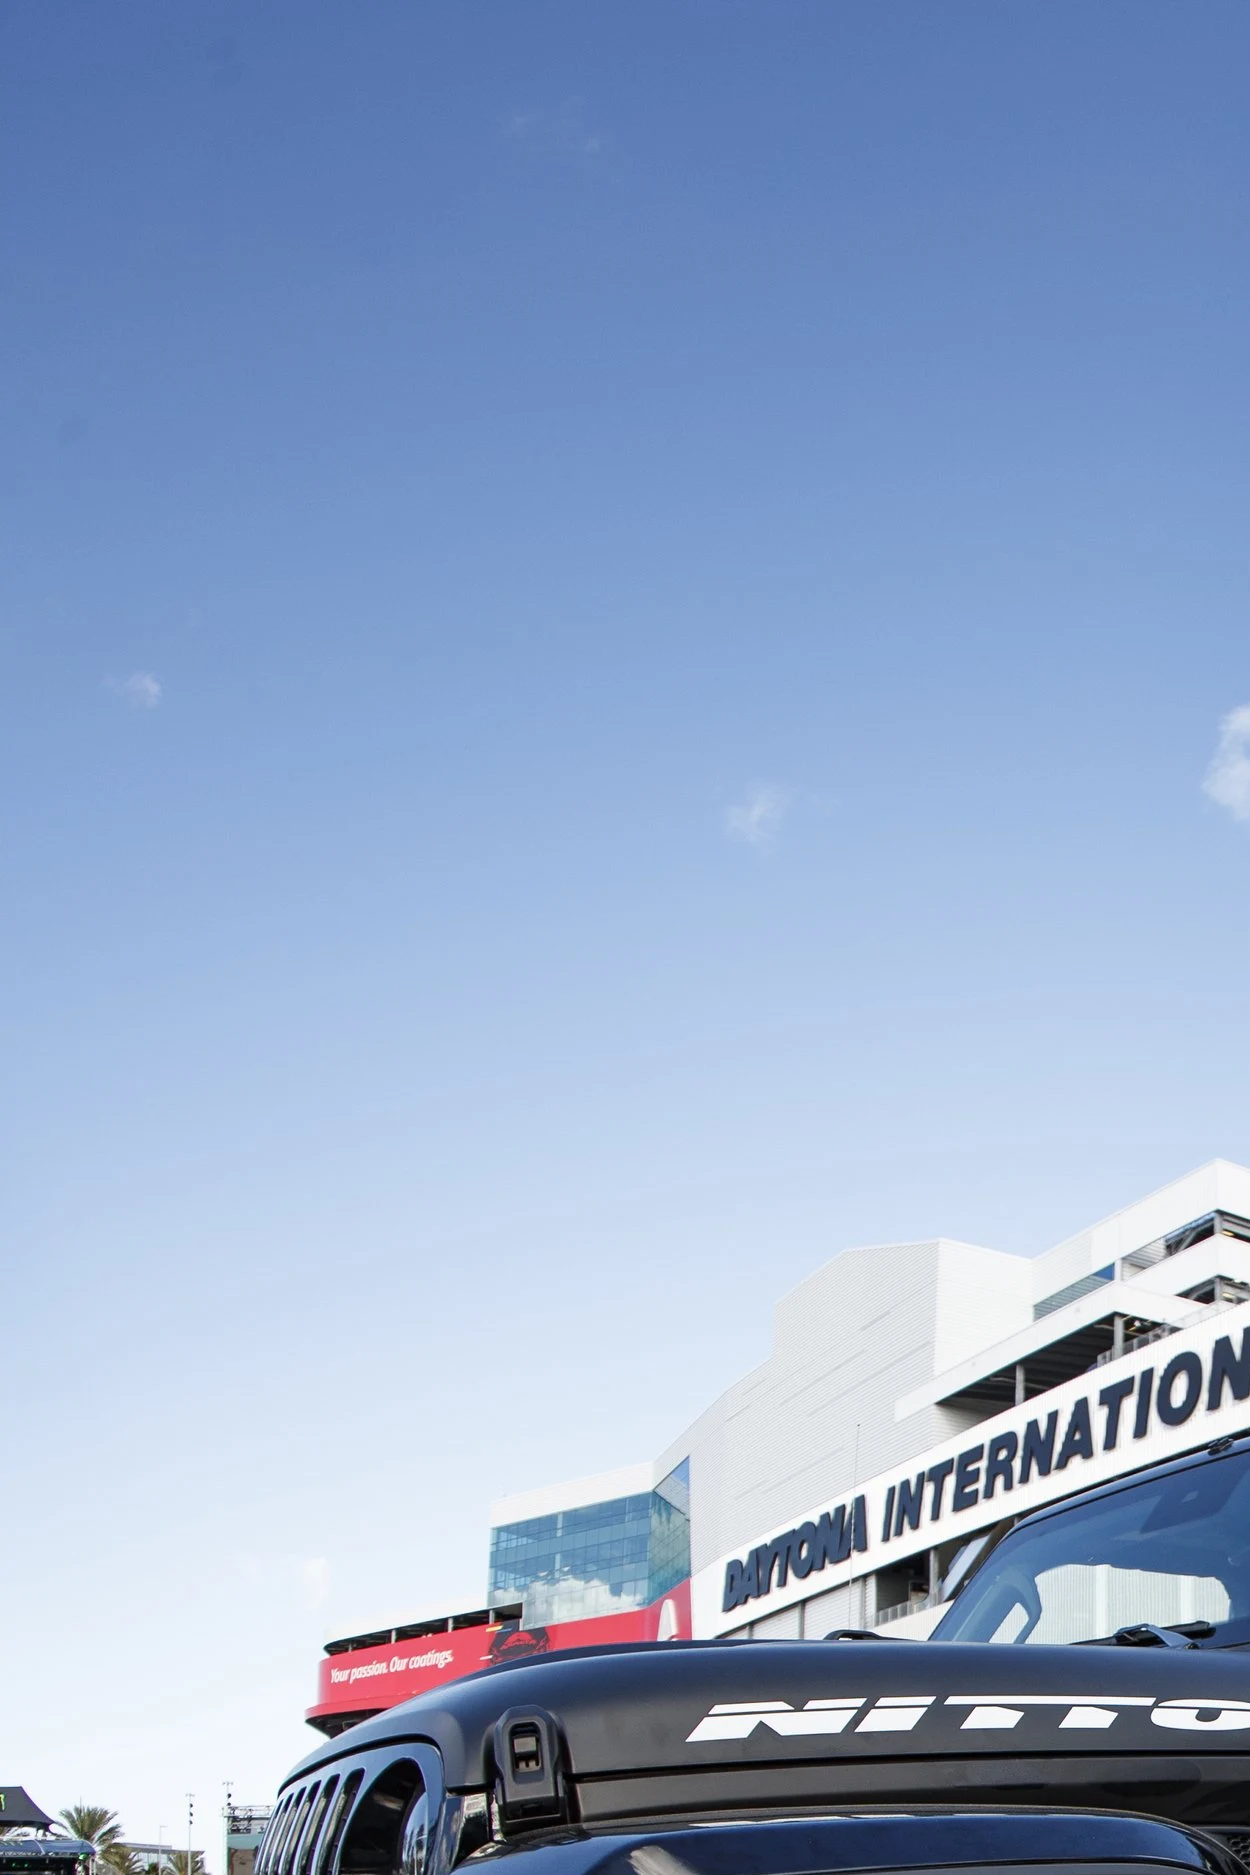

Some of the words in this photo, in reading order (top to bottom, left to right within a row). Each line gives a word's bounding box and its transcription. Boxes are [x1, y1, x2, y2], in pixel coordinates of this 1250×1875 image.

[722, 1494, 868, 1612] DAYTONA
[331, 1669, 351, 1684] Your
[350, 1661, 388, 1684] passion.
[390, 1656, 409, 1673] Our
